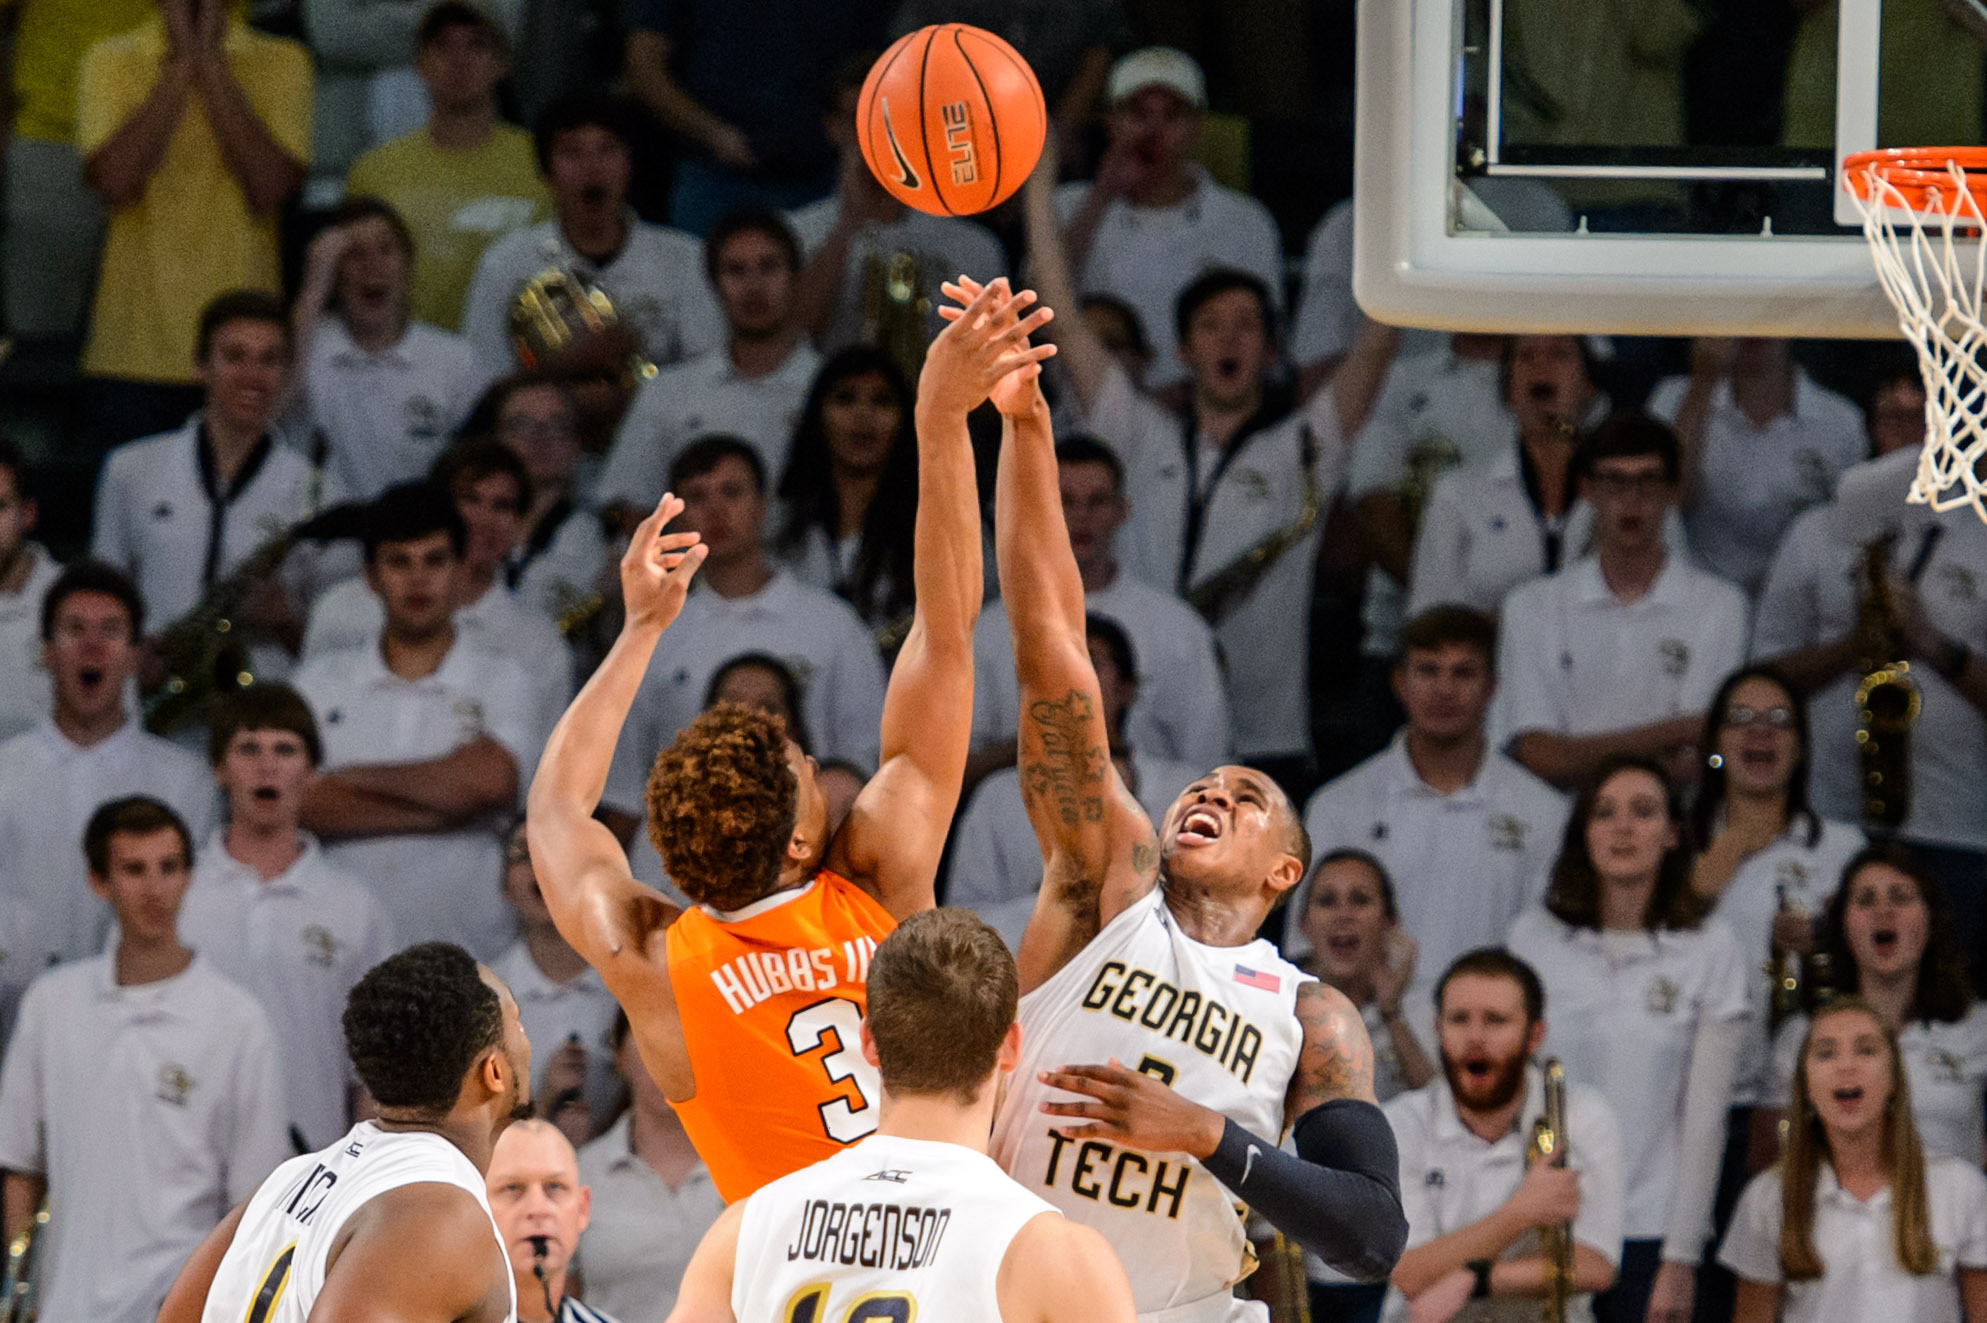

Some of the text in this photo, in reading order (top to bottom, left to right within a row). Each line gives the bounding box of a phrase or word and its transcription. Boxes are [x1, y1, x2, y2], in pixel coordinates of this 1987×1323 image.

[941, 101, 977, 186] ELITE
[710, 935, 877, 1015] HUBBS II
[1081, 959, 1263, 1087] GEORGIA
[785, 997, 881, 1145] 3
[1044, 1128, 1191, 1220] TECH
[788, 1199, 952, 1271] JORGENSON
